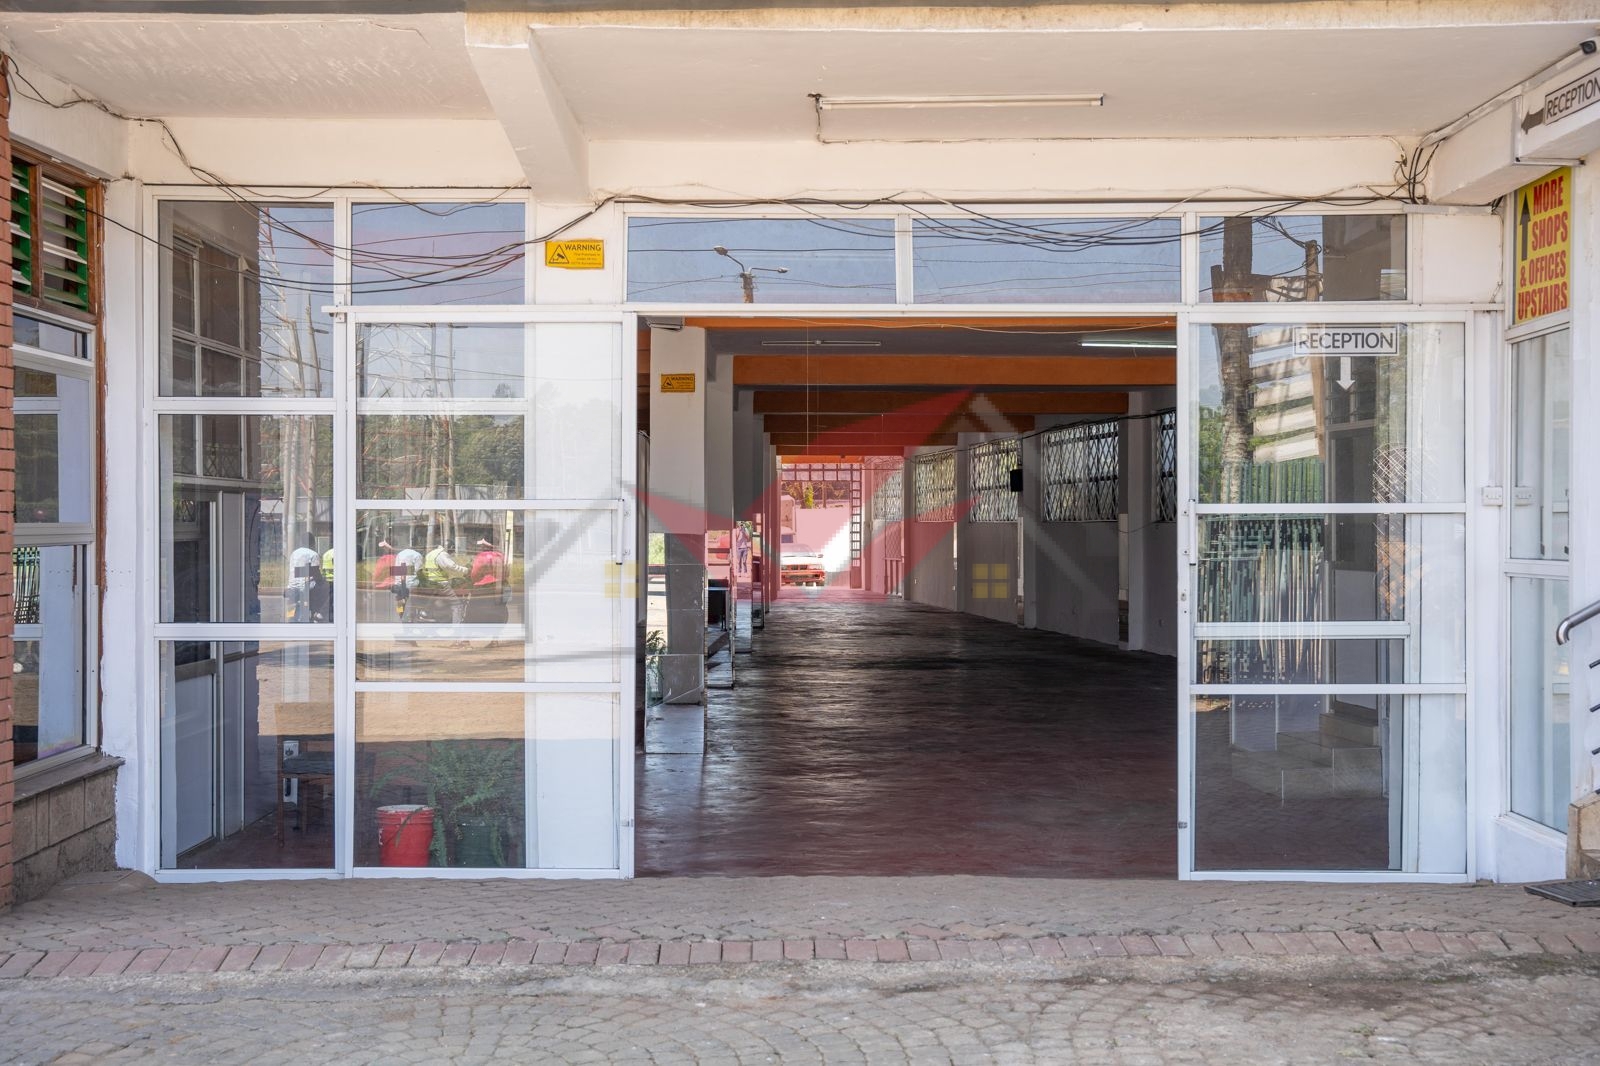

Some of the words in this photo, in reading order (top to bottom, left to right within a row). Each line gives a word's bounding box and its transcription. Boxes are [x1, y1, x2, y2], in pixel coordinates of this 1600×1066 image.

[1533, 175, 1564, 216] MORE
[564, 244, 601, 252] WARNING
[1531, 211, 1568, 251] SHOPS
[1519, 265, 1527, 288] &
[1528, 249, 1567, 285] OFFICES
[1517, 281, 1568, 321] UPSTAIRS
[1298, 332, 1394, 349] RECEPTION
